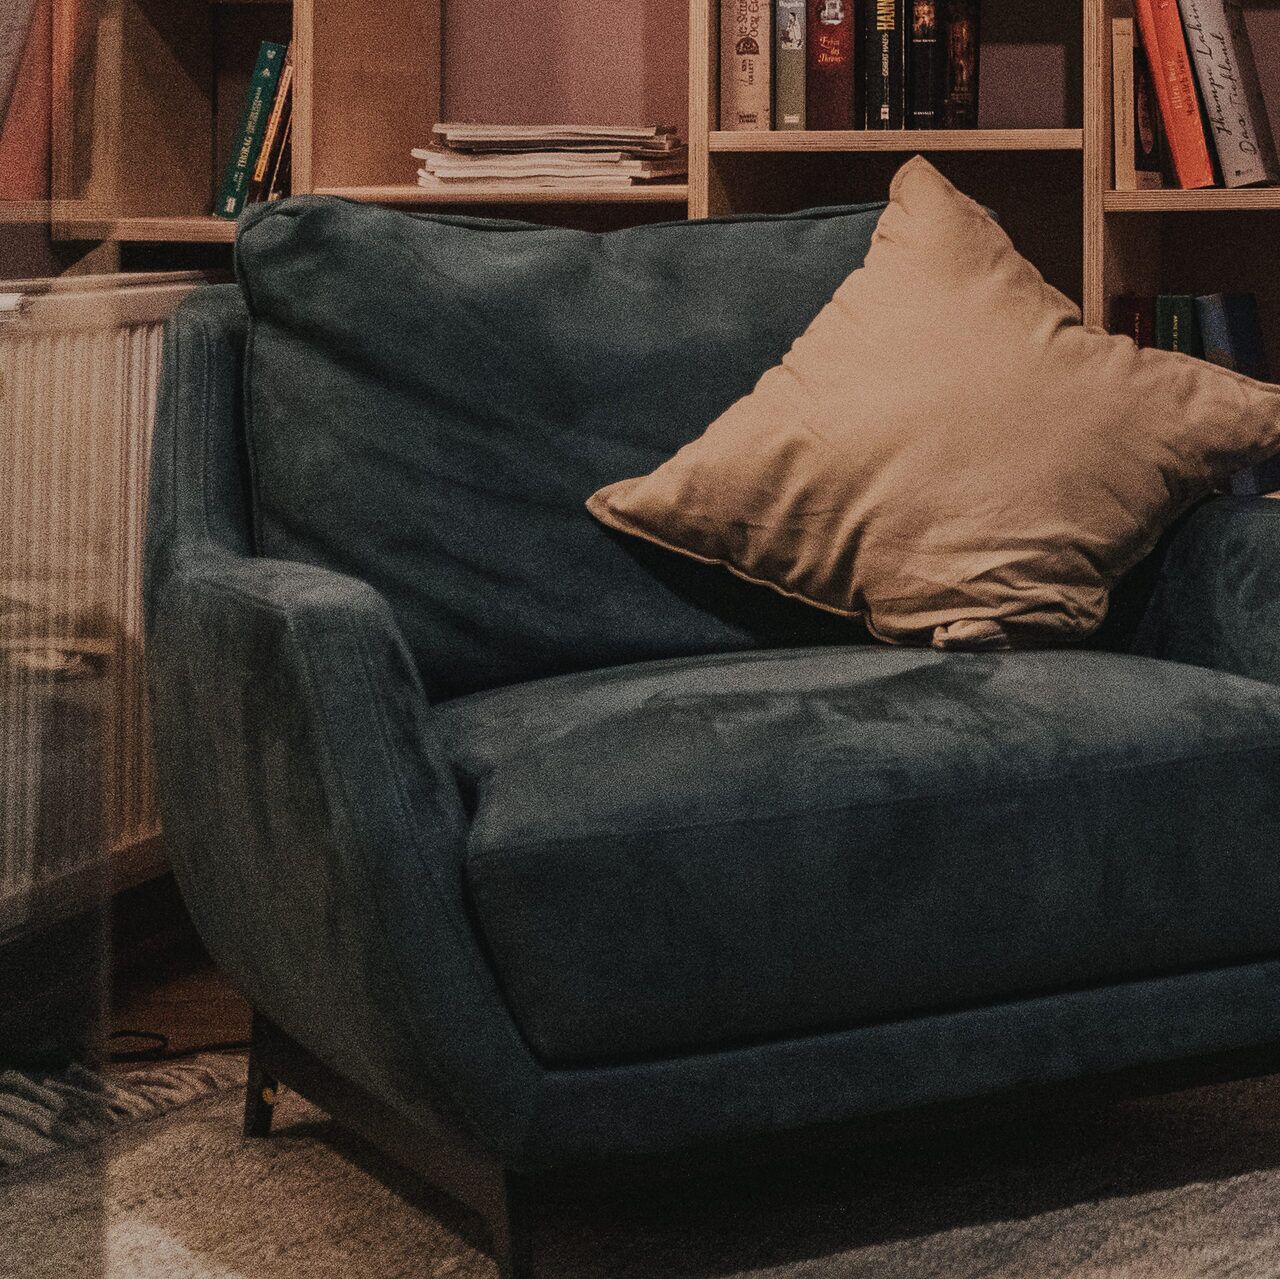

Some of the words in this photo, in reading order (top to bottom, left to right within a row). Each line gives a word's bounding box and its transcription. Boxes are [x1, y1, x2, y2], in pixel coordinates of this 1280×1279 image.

[1206, 66, 1232, 134] Jhumpa
[1210, 31, 1238, 106] Tiefland
[1236, 113, 1258, 155] Das
